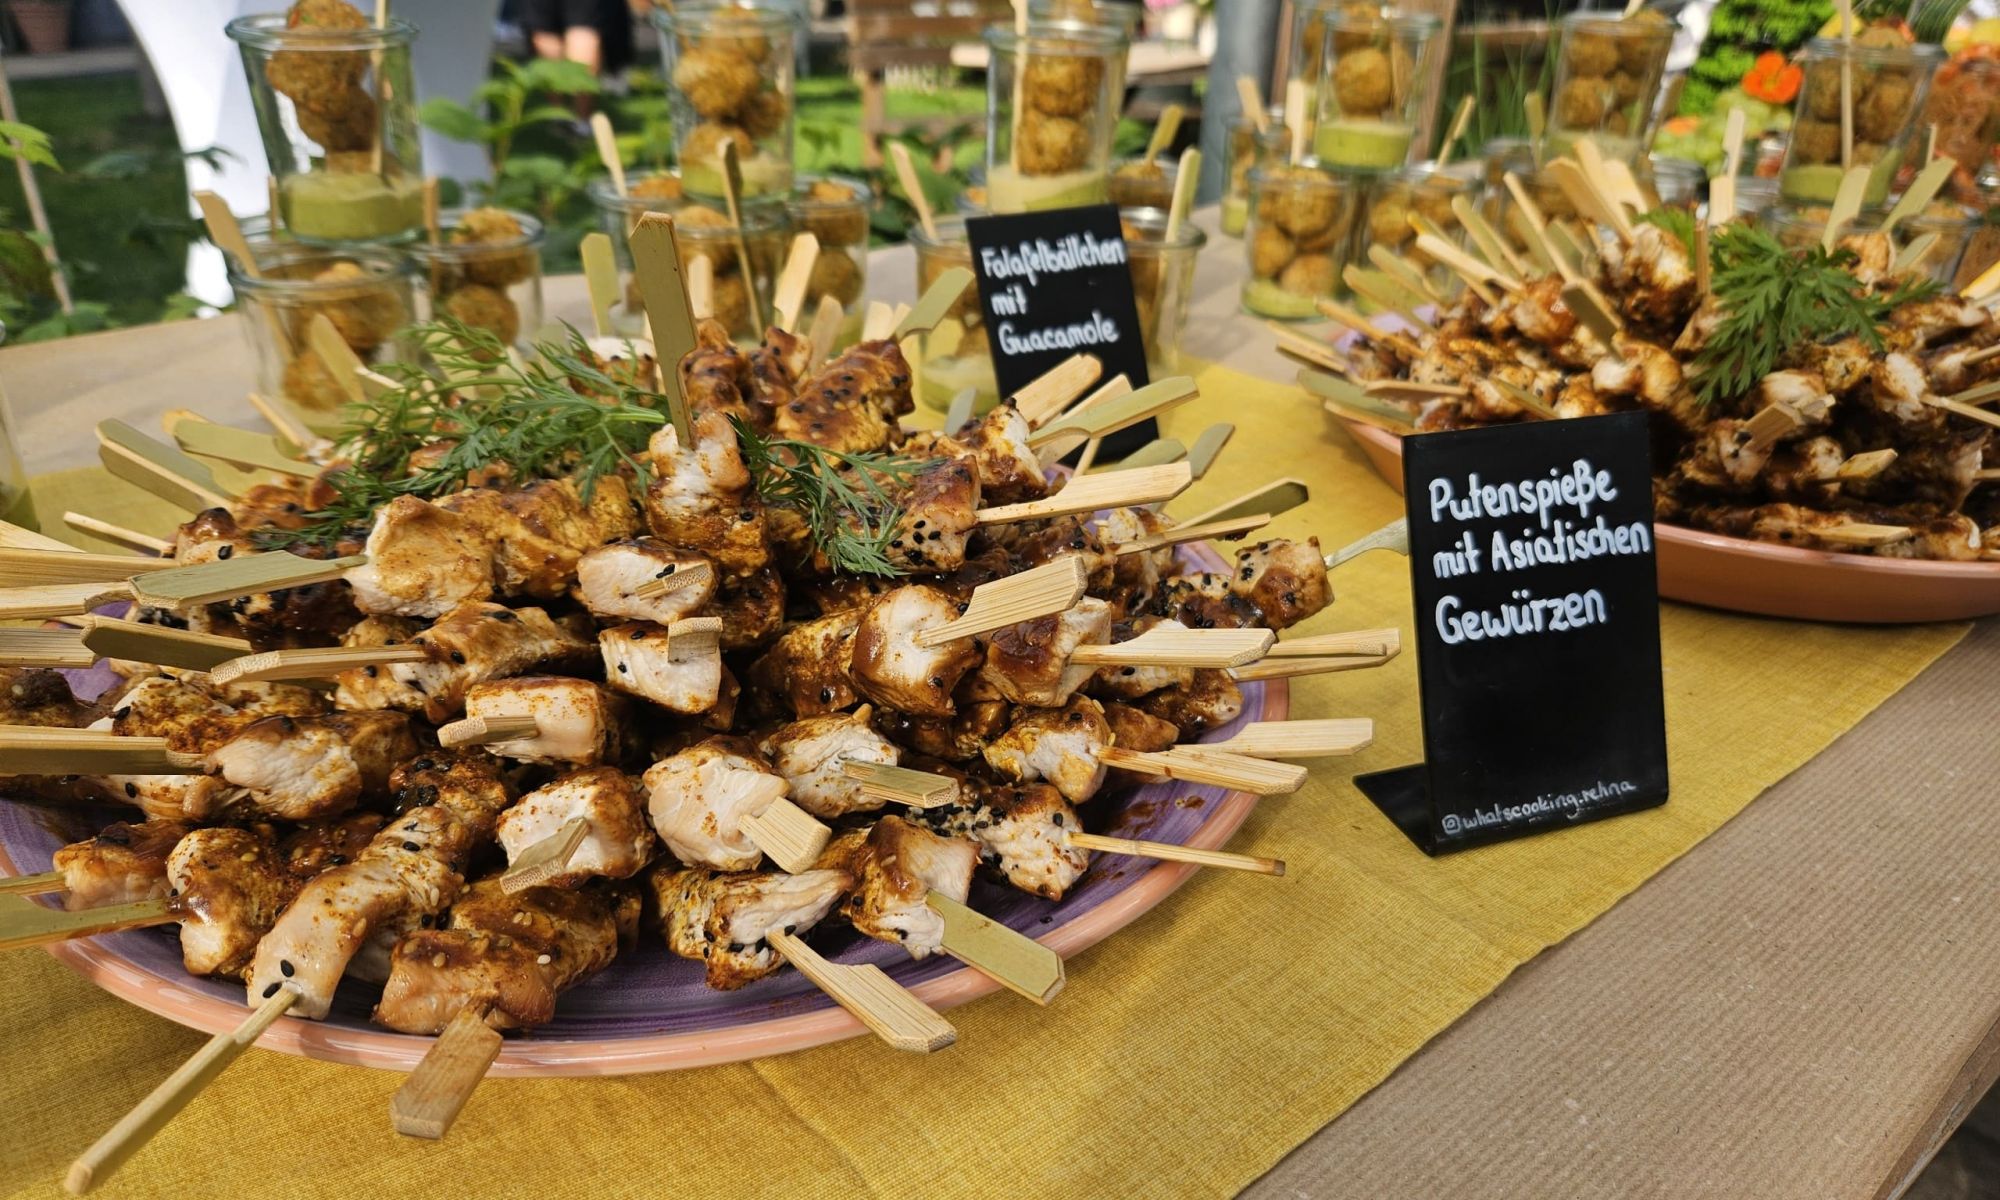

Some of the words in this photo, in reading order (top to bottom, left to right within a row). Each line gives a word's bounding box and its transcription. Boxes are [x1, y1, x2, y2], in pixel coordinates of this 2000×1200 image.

[981, 230, 1126, 286] Falafelbällchen
[991, 284, 1027, 315] mit
[998, 309, 1120, 355] Guacamole
[1429, 458, 1618, 529] Putenspieße
[1433, 531, 1479, 578] mit
[1491, 515, 1650, 571] Asiatischen
[1435, 588, 1606, 644] Gewürzen
